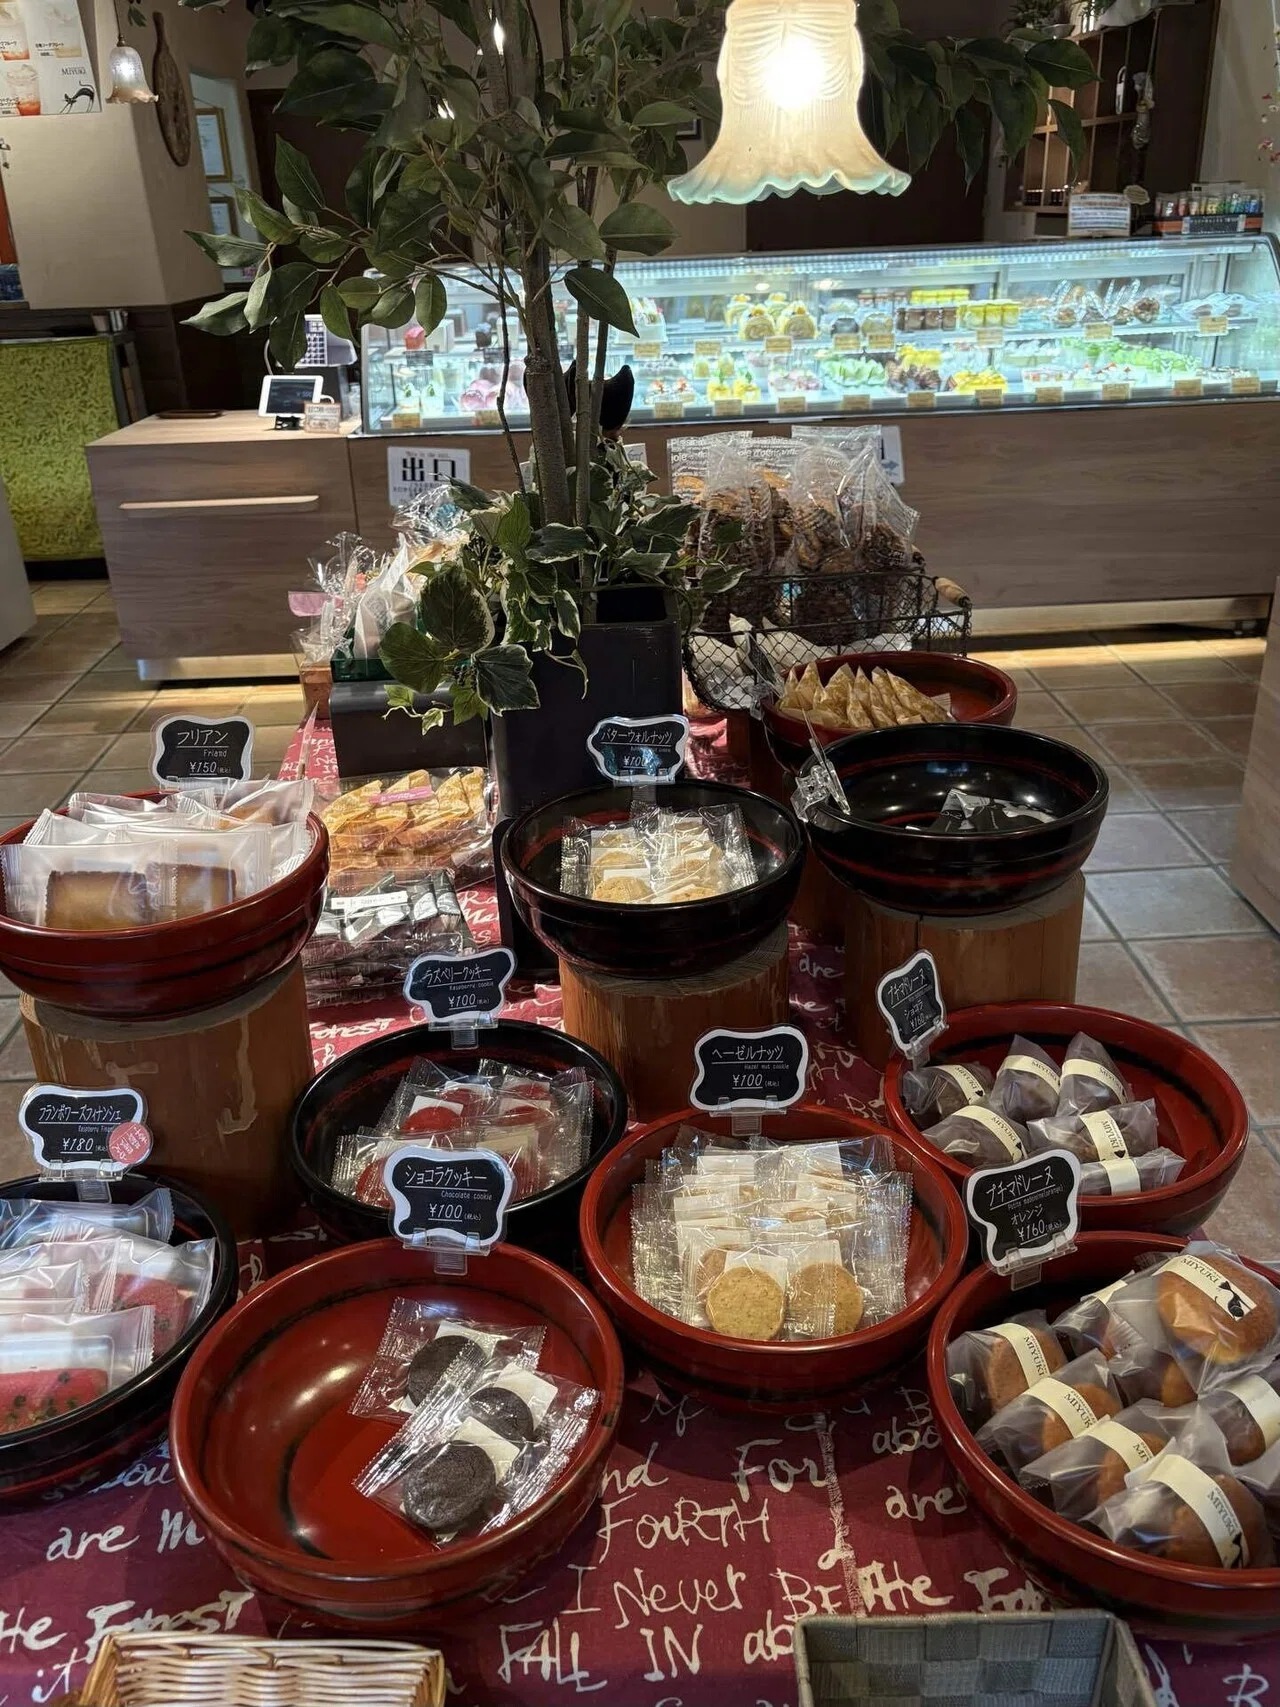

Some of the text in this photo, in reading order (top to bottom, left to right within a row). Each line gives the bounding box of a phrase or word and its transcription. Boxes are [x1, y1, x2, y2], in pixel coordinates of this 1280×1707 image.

[402, 457, 456, 482] 出口
[177, 728, 229, 746] フリアン
[601, 727, 673, 745] バターウォルナッツ
[189, 761, 218, 773] ¥150
[421, 963, 492, 986] ラズベリークッキー
[448, 993, 477, 1008] ¥100
[712, 1044, 784, 1061] ヘーゼルナッツ
[732, 1073, 763, 1087] ¥100
[62, 1137, 94, 1151] ¥180
[1100, 1119, 1121, 1150] MIYUKI
[405, 1164, 487, 1187] ショコラクッキー
[985, 1164, 1054, 1207] プチマドレーヌ
[441, 1191, 493, 1201] Chocolate cookie
[429, 1203, 463, 1219] ¥100
[1010, 1203, 1044, 1226] オレンジ
[1016, 1219, 1045, 1241] ¥160
[1180, 1258, 1219, 1283] MIYUKI
[1023, 1335, 1046, 1378] MIYUKI
[1063, 1392, 1096, 1430] MIYUK
[1207, 1489, 1237, 1538] MIYUKI
[47, 1525, 140, 1561] are
